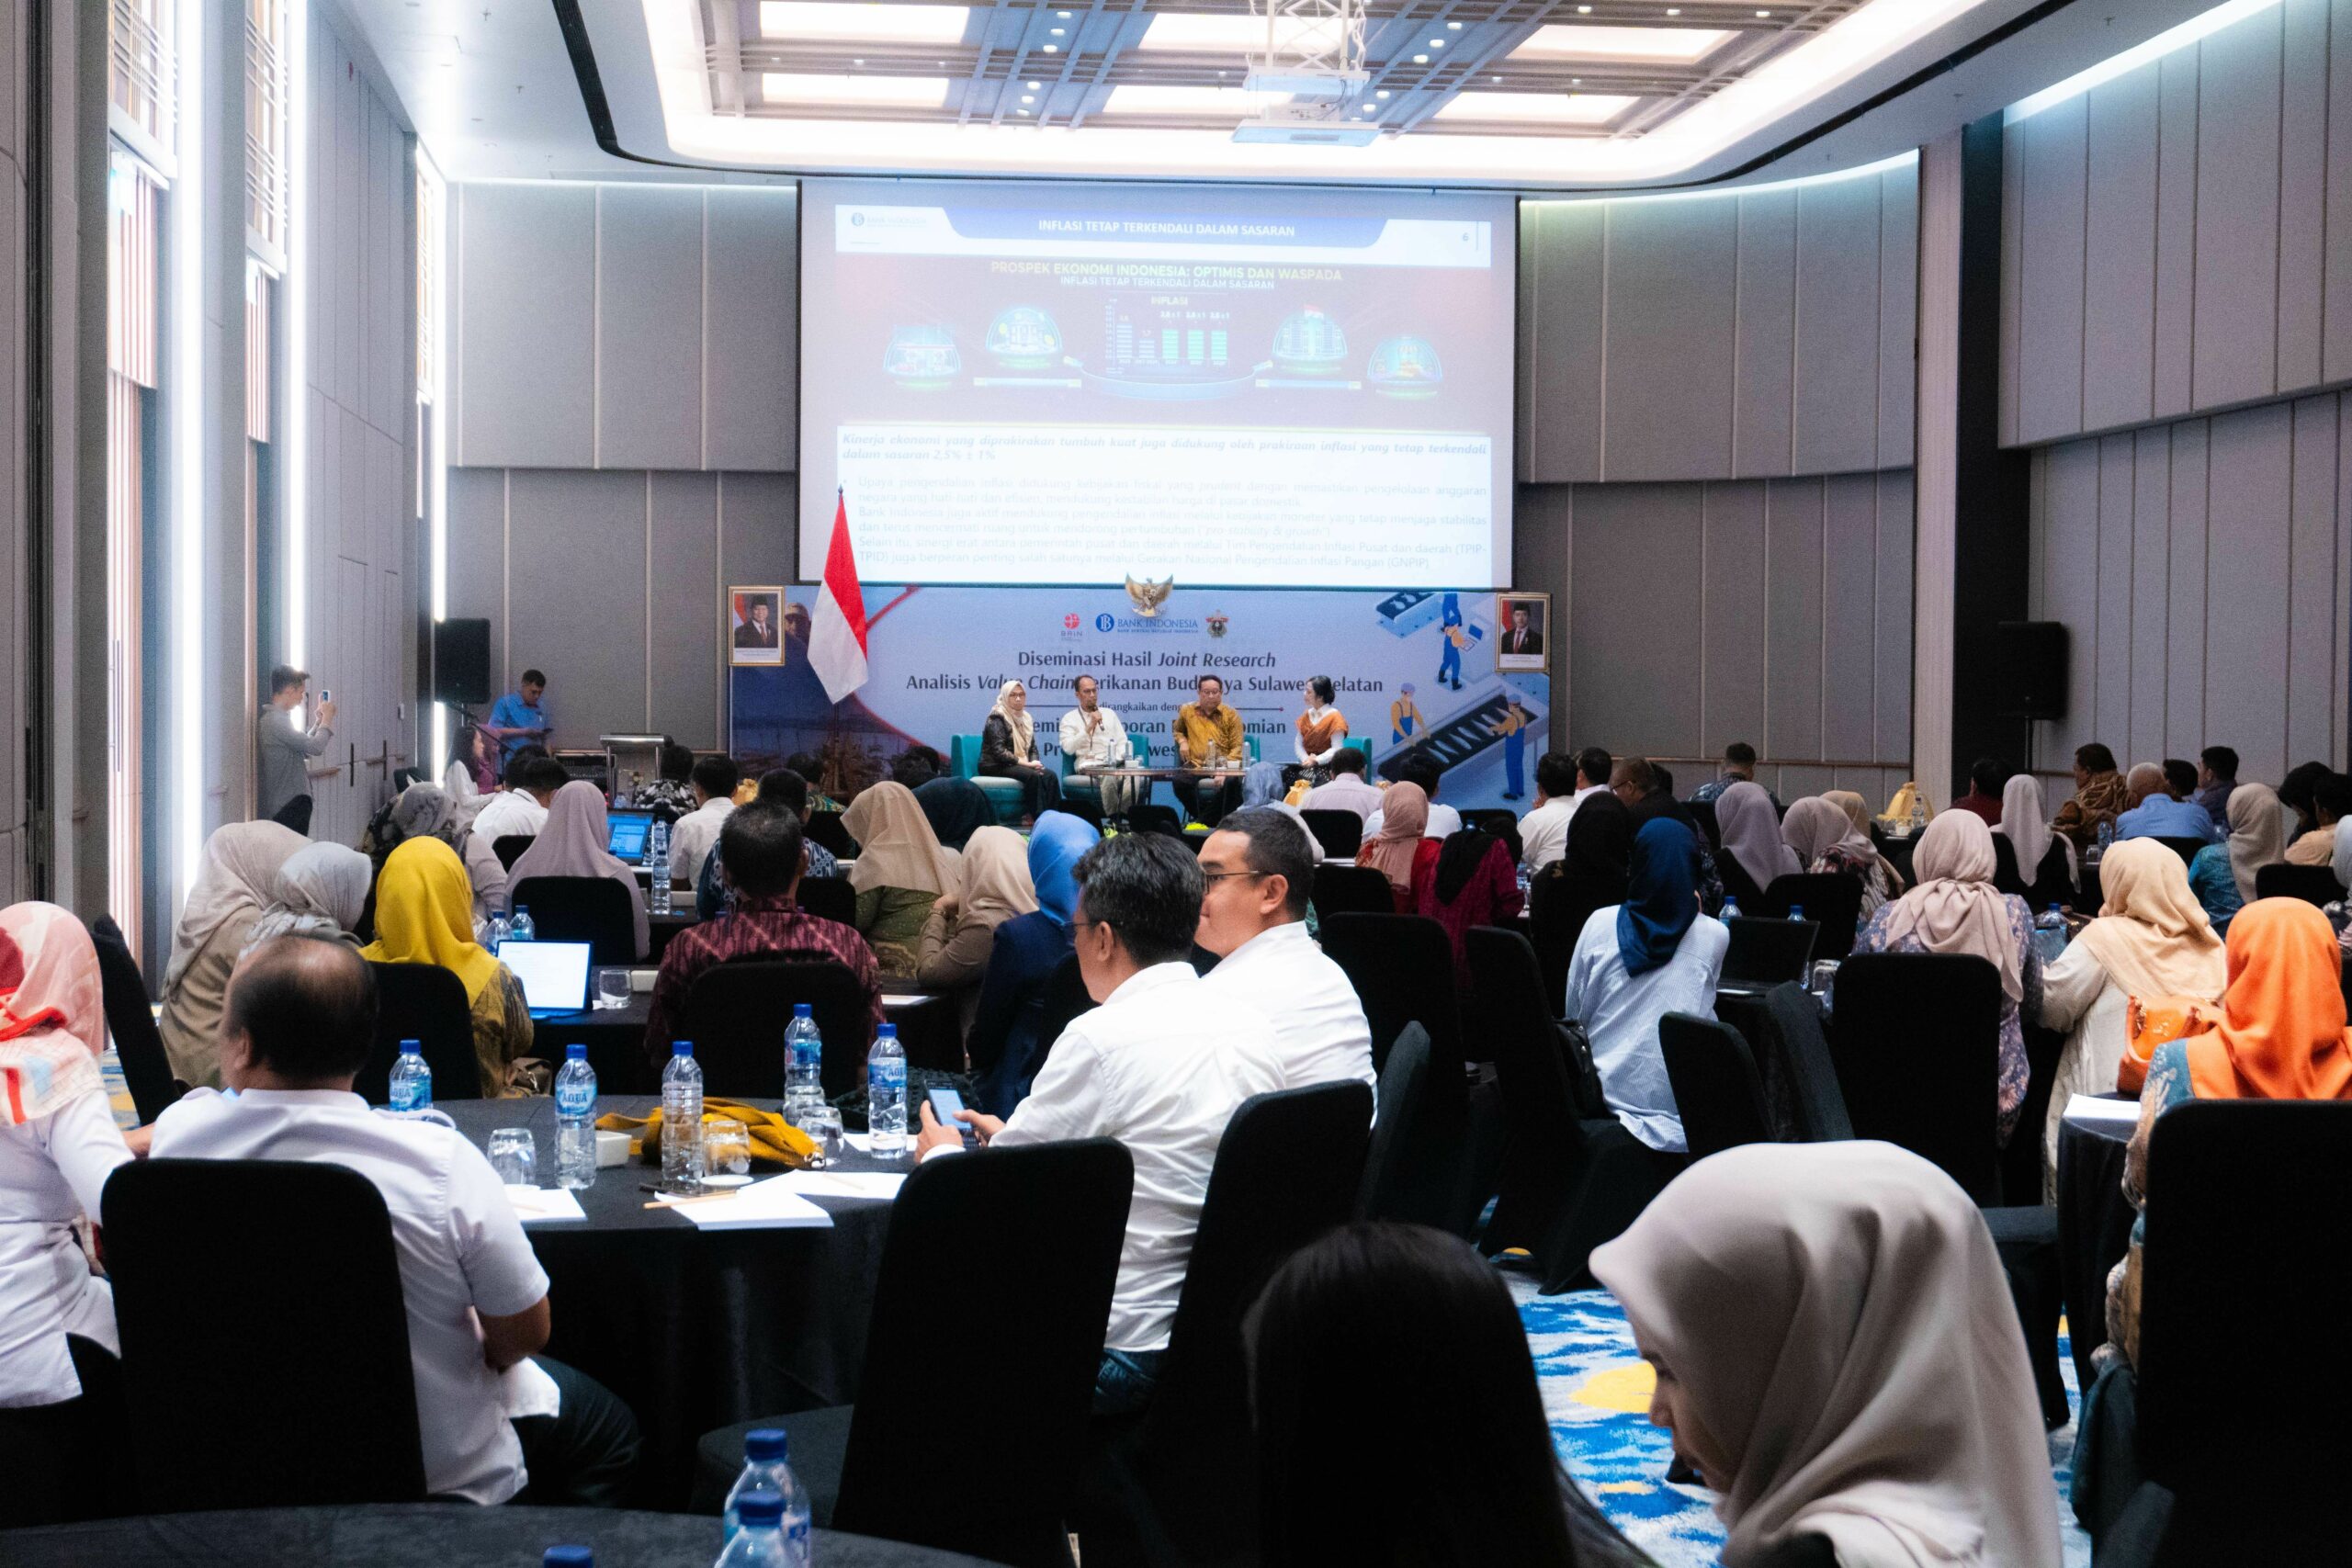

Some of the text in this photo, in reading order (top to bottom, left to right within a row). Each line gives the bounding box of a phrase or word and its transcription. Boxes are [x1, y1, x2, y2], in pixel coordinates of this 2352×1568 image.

[1038, 220, 1295, 236] INFLASI TETAP TERKENDALI DALAM SASARAN
[1462, 232, 1469, 242] 6
[991, 261, 1342, 280] PROSPEK EKONOMI INDONESIA: OPTIMIS DAN WASPADA
[1060, 276, 1275, 289] INFLASI TETAP TERKENDALI DALAM SASARAN
[1150, 296, 1189, 306] INFLASI
[842, 434, 1487, 456] Kinerja ekonomi yang diprakirakan tumbuh kuat juga didukung oleh prakiraan inflasi yang tetap terkendali
[842, 448, 881, 458] dalam
[885, 451, 930, 459] sasaran
[933, 449, 962, 463] 2,5%
[978, 450, 996, 460] 1%
[1117, 618, 1143, 627] BANK
[1146, 618, 1198, 628] INDONESIA
[1018, 650, 1276, 668] Diseminasi Hasil Joint Research
[906, 673, 1383, 695] Analisis Val Chain erikanan Budya Sulawe elatan
[561, 1093, 588, 1103] AQUA
